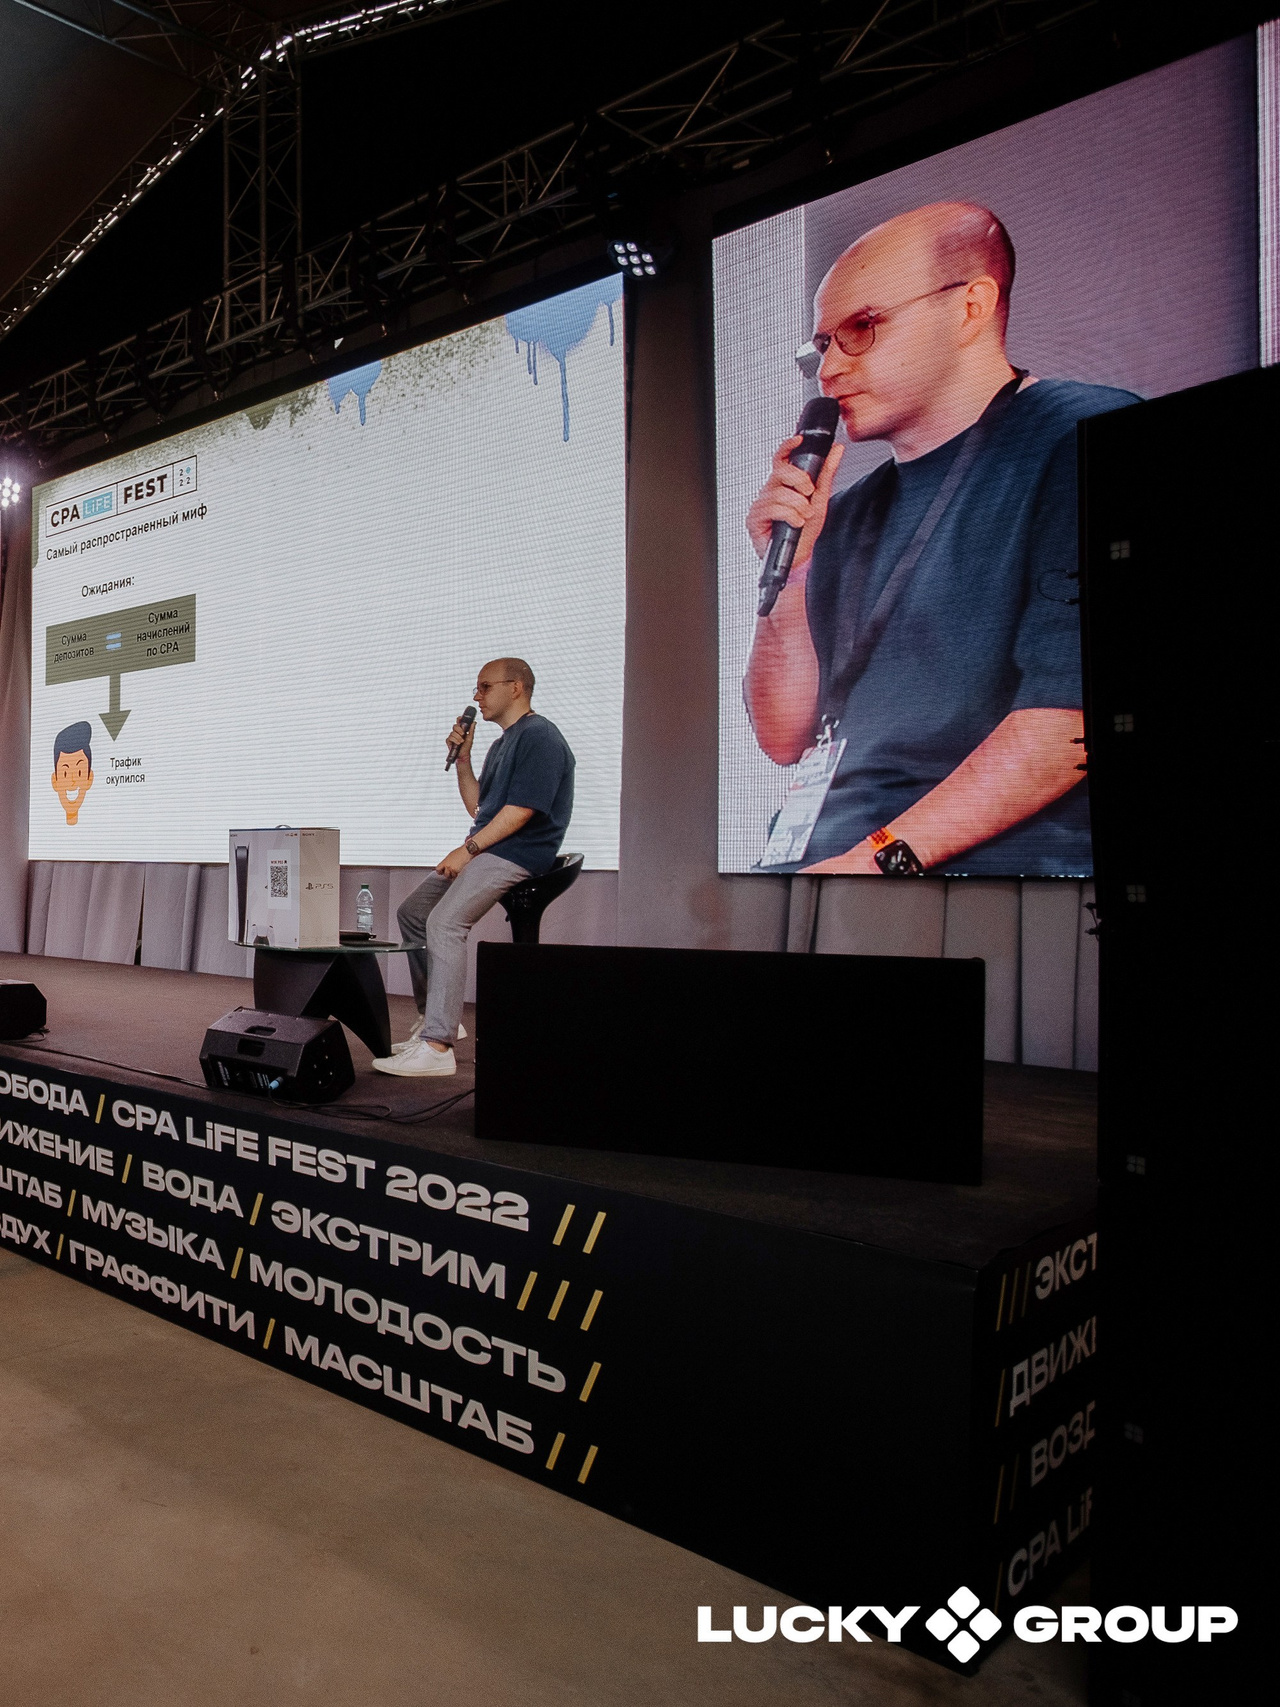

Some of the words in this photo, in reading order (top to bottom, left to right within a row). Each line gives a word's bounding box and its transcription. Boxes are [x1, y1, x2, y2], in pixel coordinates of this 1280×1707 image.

[51, 504, 80, 527] CPA
[85, 495, 110, 514] LiFE
[124, 474, 167, 504] FEST
[46, 541, 78, 560] Самый
[80, 513, 179, 554] распространенный
[182, 503, 208, 522] миф
[81, 576, 135, 598] Ожидания:
[148, 608, 178, 625] Сумма
[61, 632, 87, 646] Сумма
[136, 622, 190, 642] начислений
[53, 646, 94, 663] депозитов
[146, 647, 157, 657] по
[110, 756, 142, 770] Трафик
[106, 773, 145, 786] окупился
[112, 1100, 179, 1141] CPA
[186, 1116, 259, 1162] LiFE
[268, 1136, 375, 1190] FEST
[386, 1166, 529, 1232] 2022
[143, 1161, 244, 1218] ВОДА
[271, 1200, 506, 1300] ЭКСТРИМ
[82, 1194, 225, 1271] МУЗЫКА
[250, 1254, 566, 1393] МОЛОДОСТЬ
[69, 1240, 255, 1340] ГРАФФИТИ
[284, 1326, 534, 1454] МАСШТАБ
[1007, 1519, 1062, 1597] CPA
